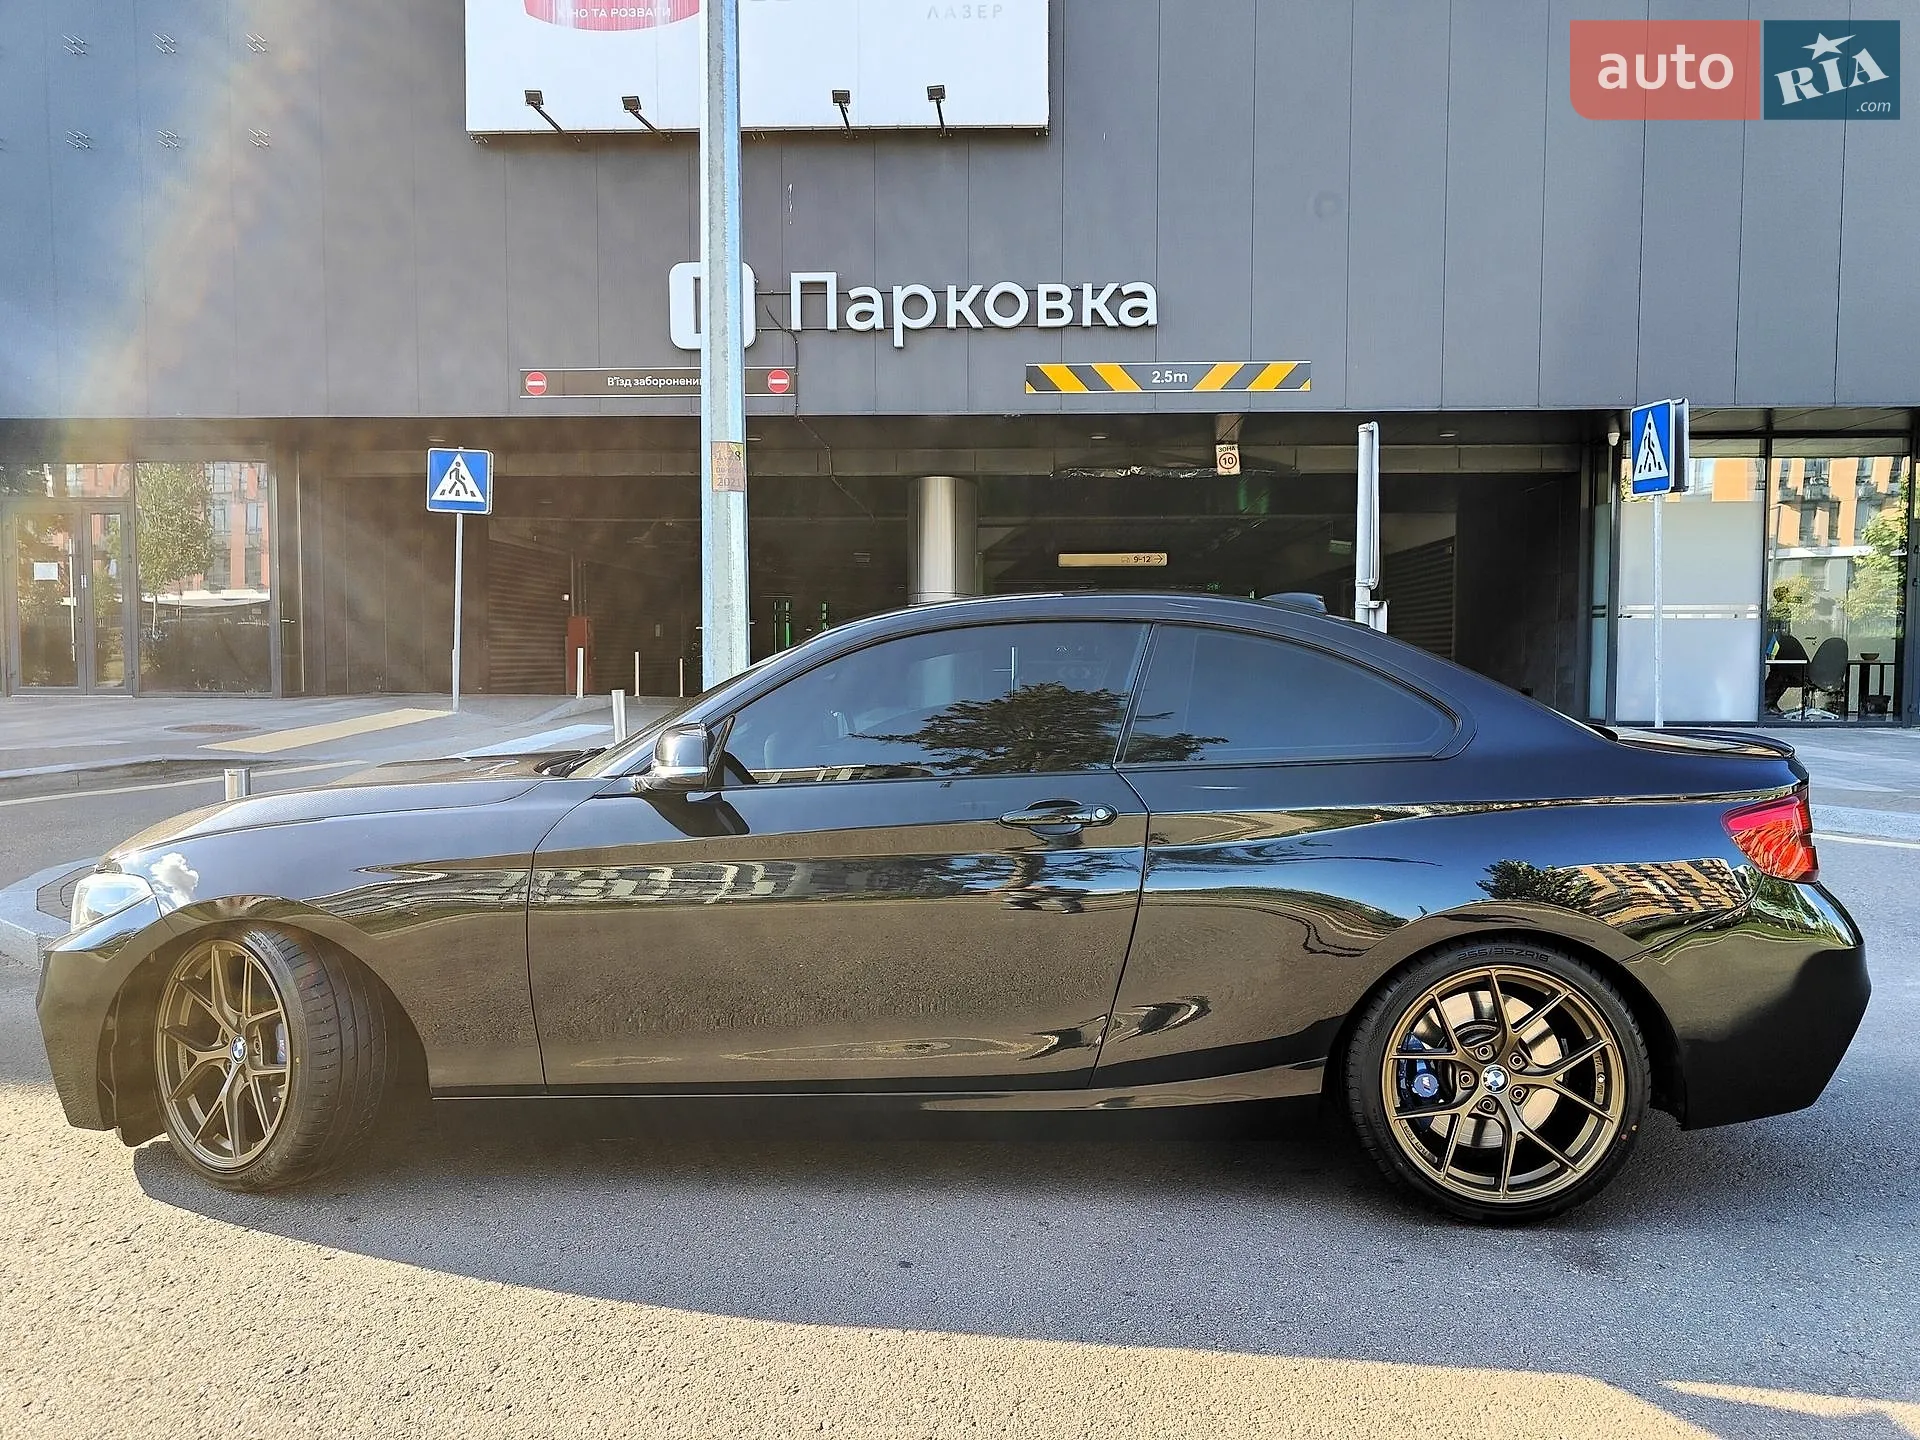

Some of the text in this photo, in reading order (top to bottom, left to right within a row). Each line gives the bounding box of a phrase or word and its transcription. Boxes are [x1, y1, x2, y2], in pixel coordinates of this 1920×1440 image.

[591, 8, 608, 17] ТА
[611, 7, 671, 18] РОЗВАГИ
[927, 4, 1003, 20] ЛАЗЕР
[790, 271, 1158, 348] Парковка
[634, 375, 702, 388] заборонени
[1222, 456, 1234, 466] 10
[1133, 555, 1151, 563] 9-12
[1456, 947, 1550, 963] 255/35ZR18
